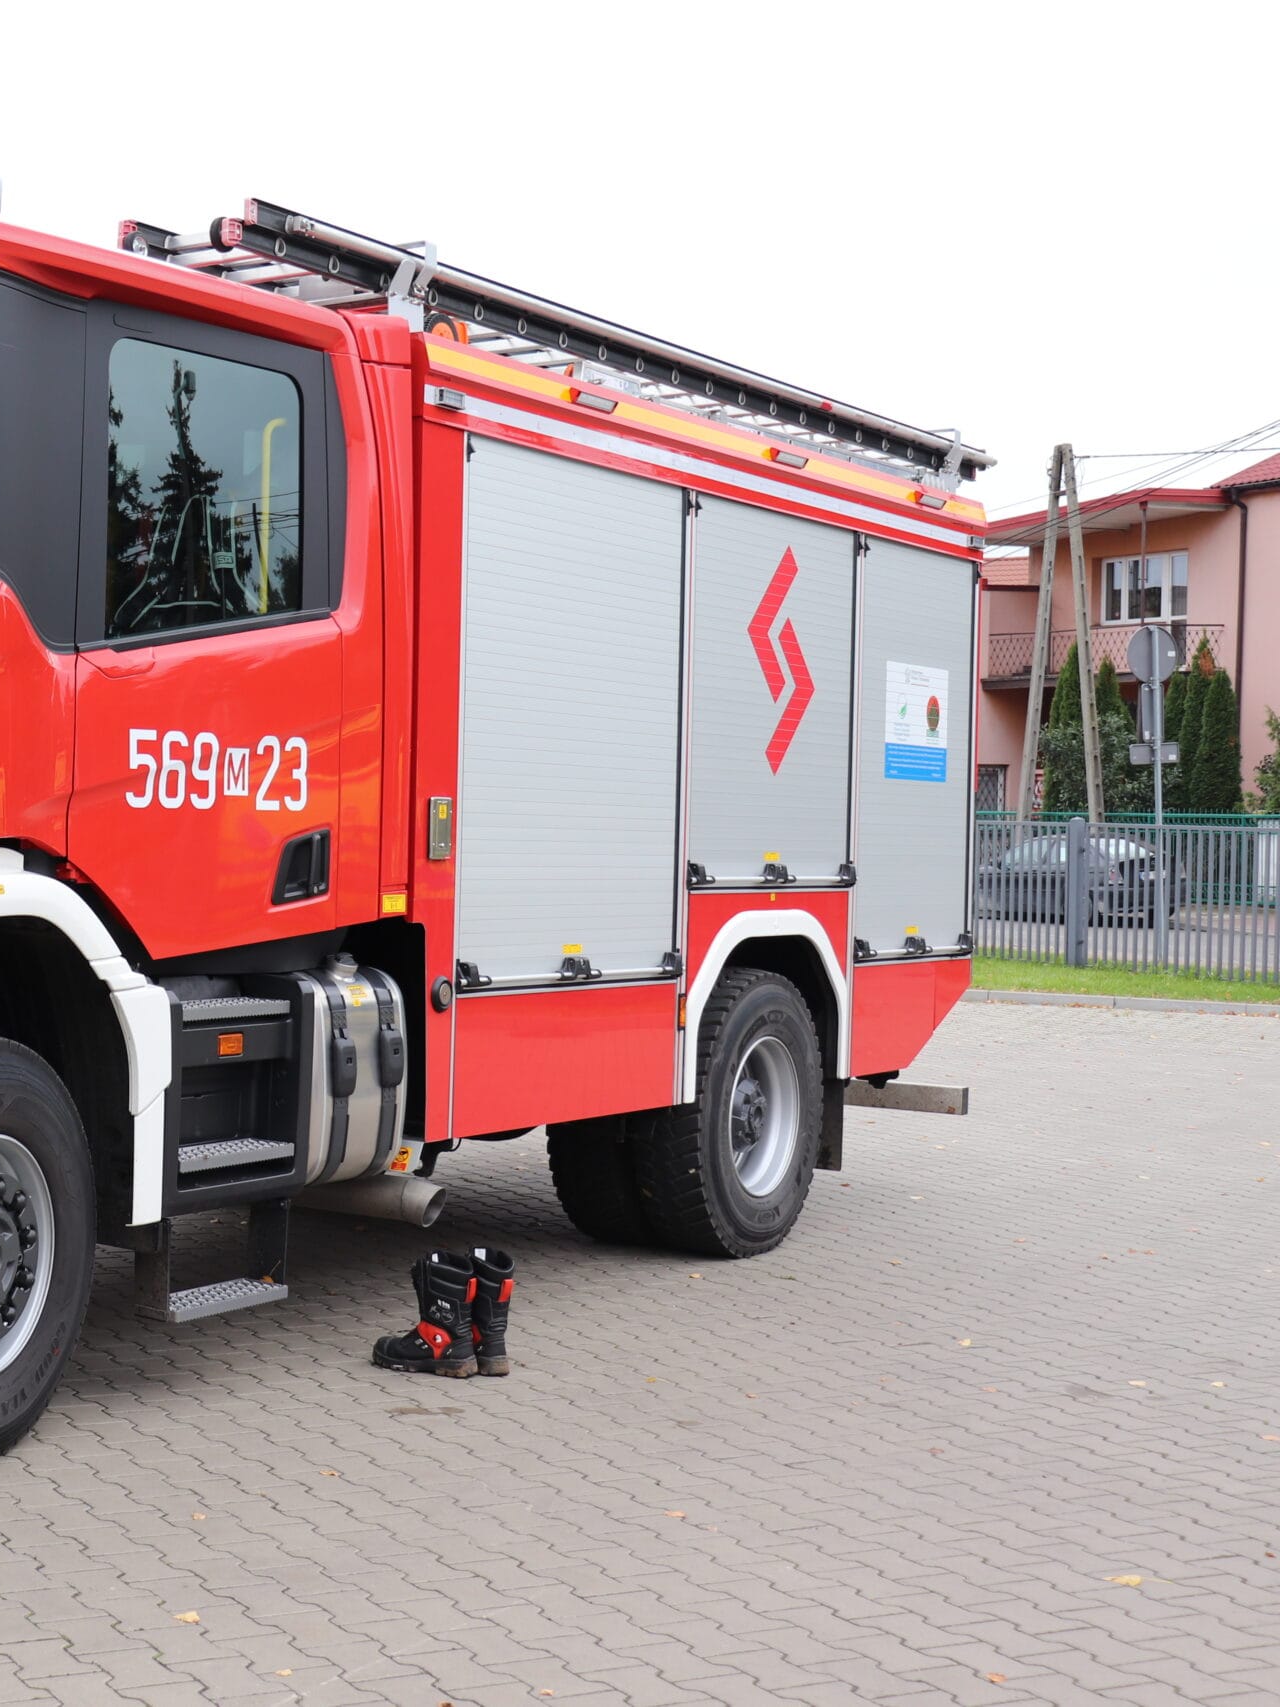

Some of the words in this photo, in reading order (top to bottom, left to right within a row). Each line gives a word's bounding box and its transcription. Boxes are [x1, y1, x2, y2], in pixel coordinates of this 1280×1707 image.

[125, 728, 219, 810] 569
[225, 750, 248, 793] M
[256, 735, 308, 812] 23
